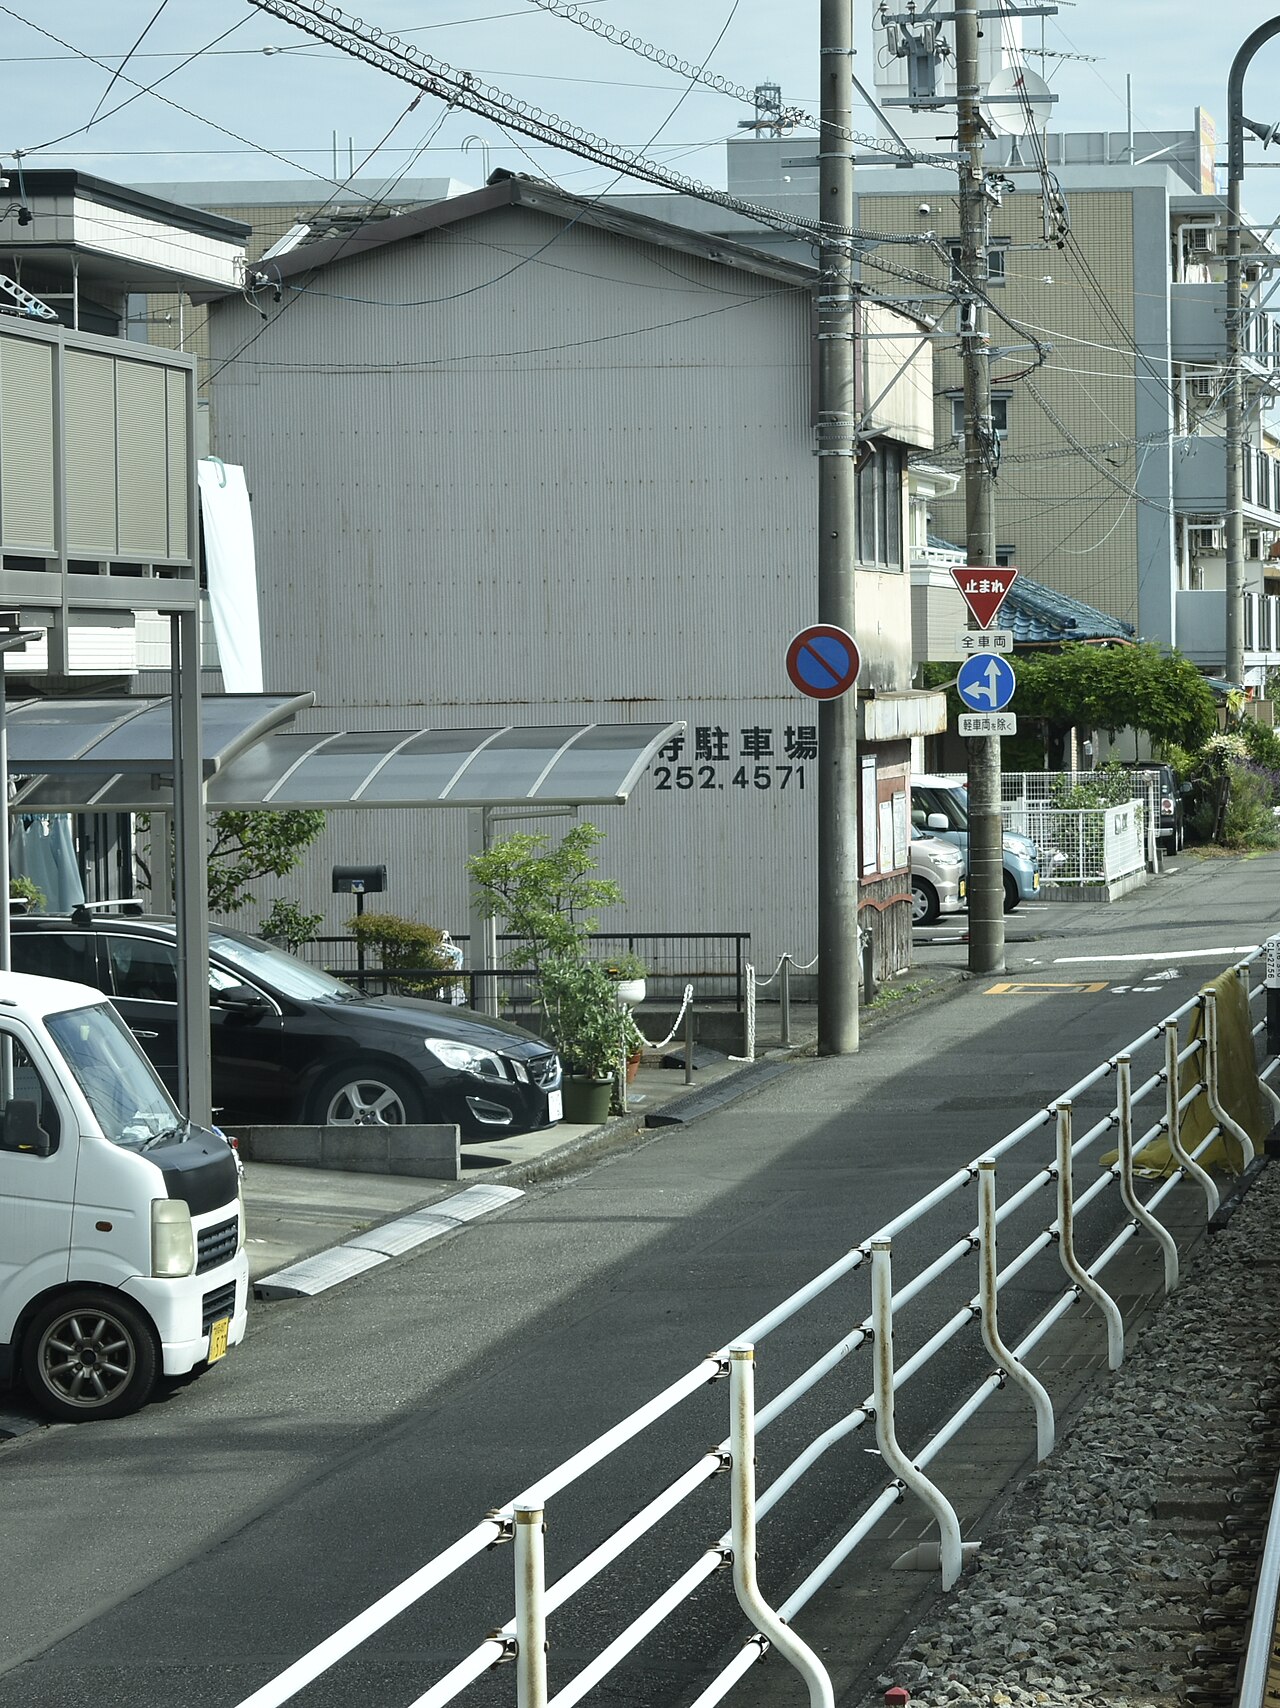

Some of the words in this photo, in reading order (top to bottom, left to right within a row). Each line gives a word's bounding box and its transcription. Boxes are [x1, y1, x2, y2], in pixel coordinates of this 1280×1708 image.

[964, 579, 1005, 594] 止まれ
[962, 635, 1006, 649] 全車両
[963, 718, 1012, 732] 軽車両を除く
[653, 765, 805, 790] 252.4571
